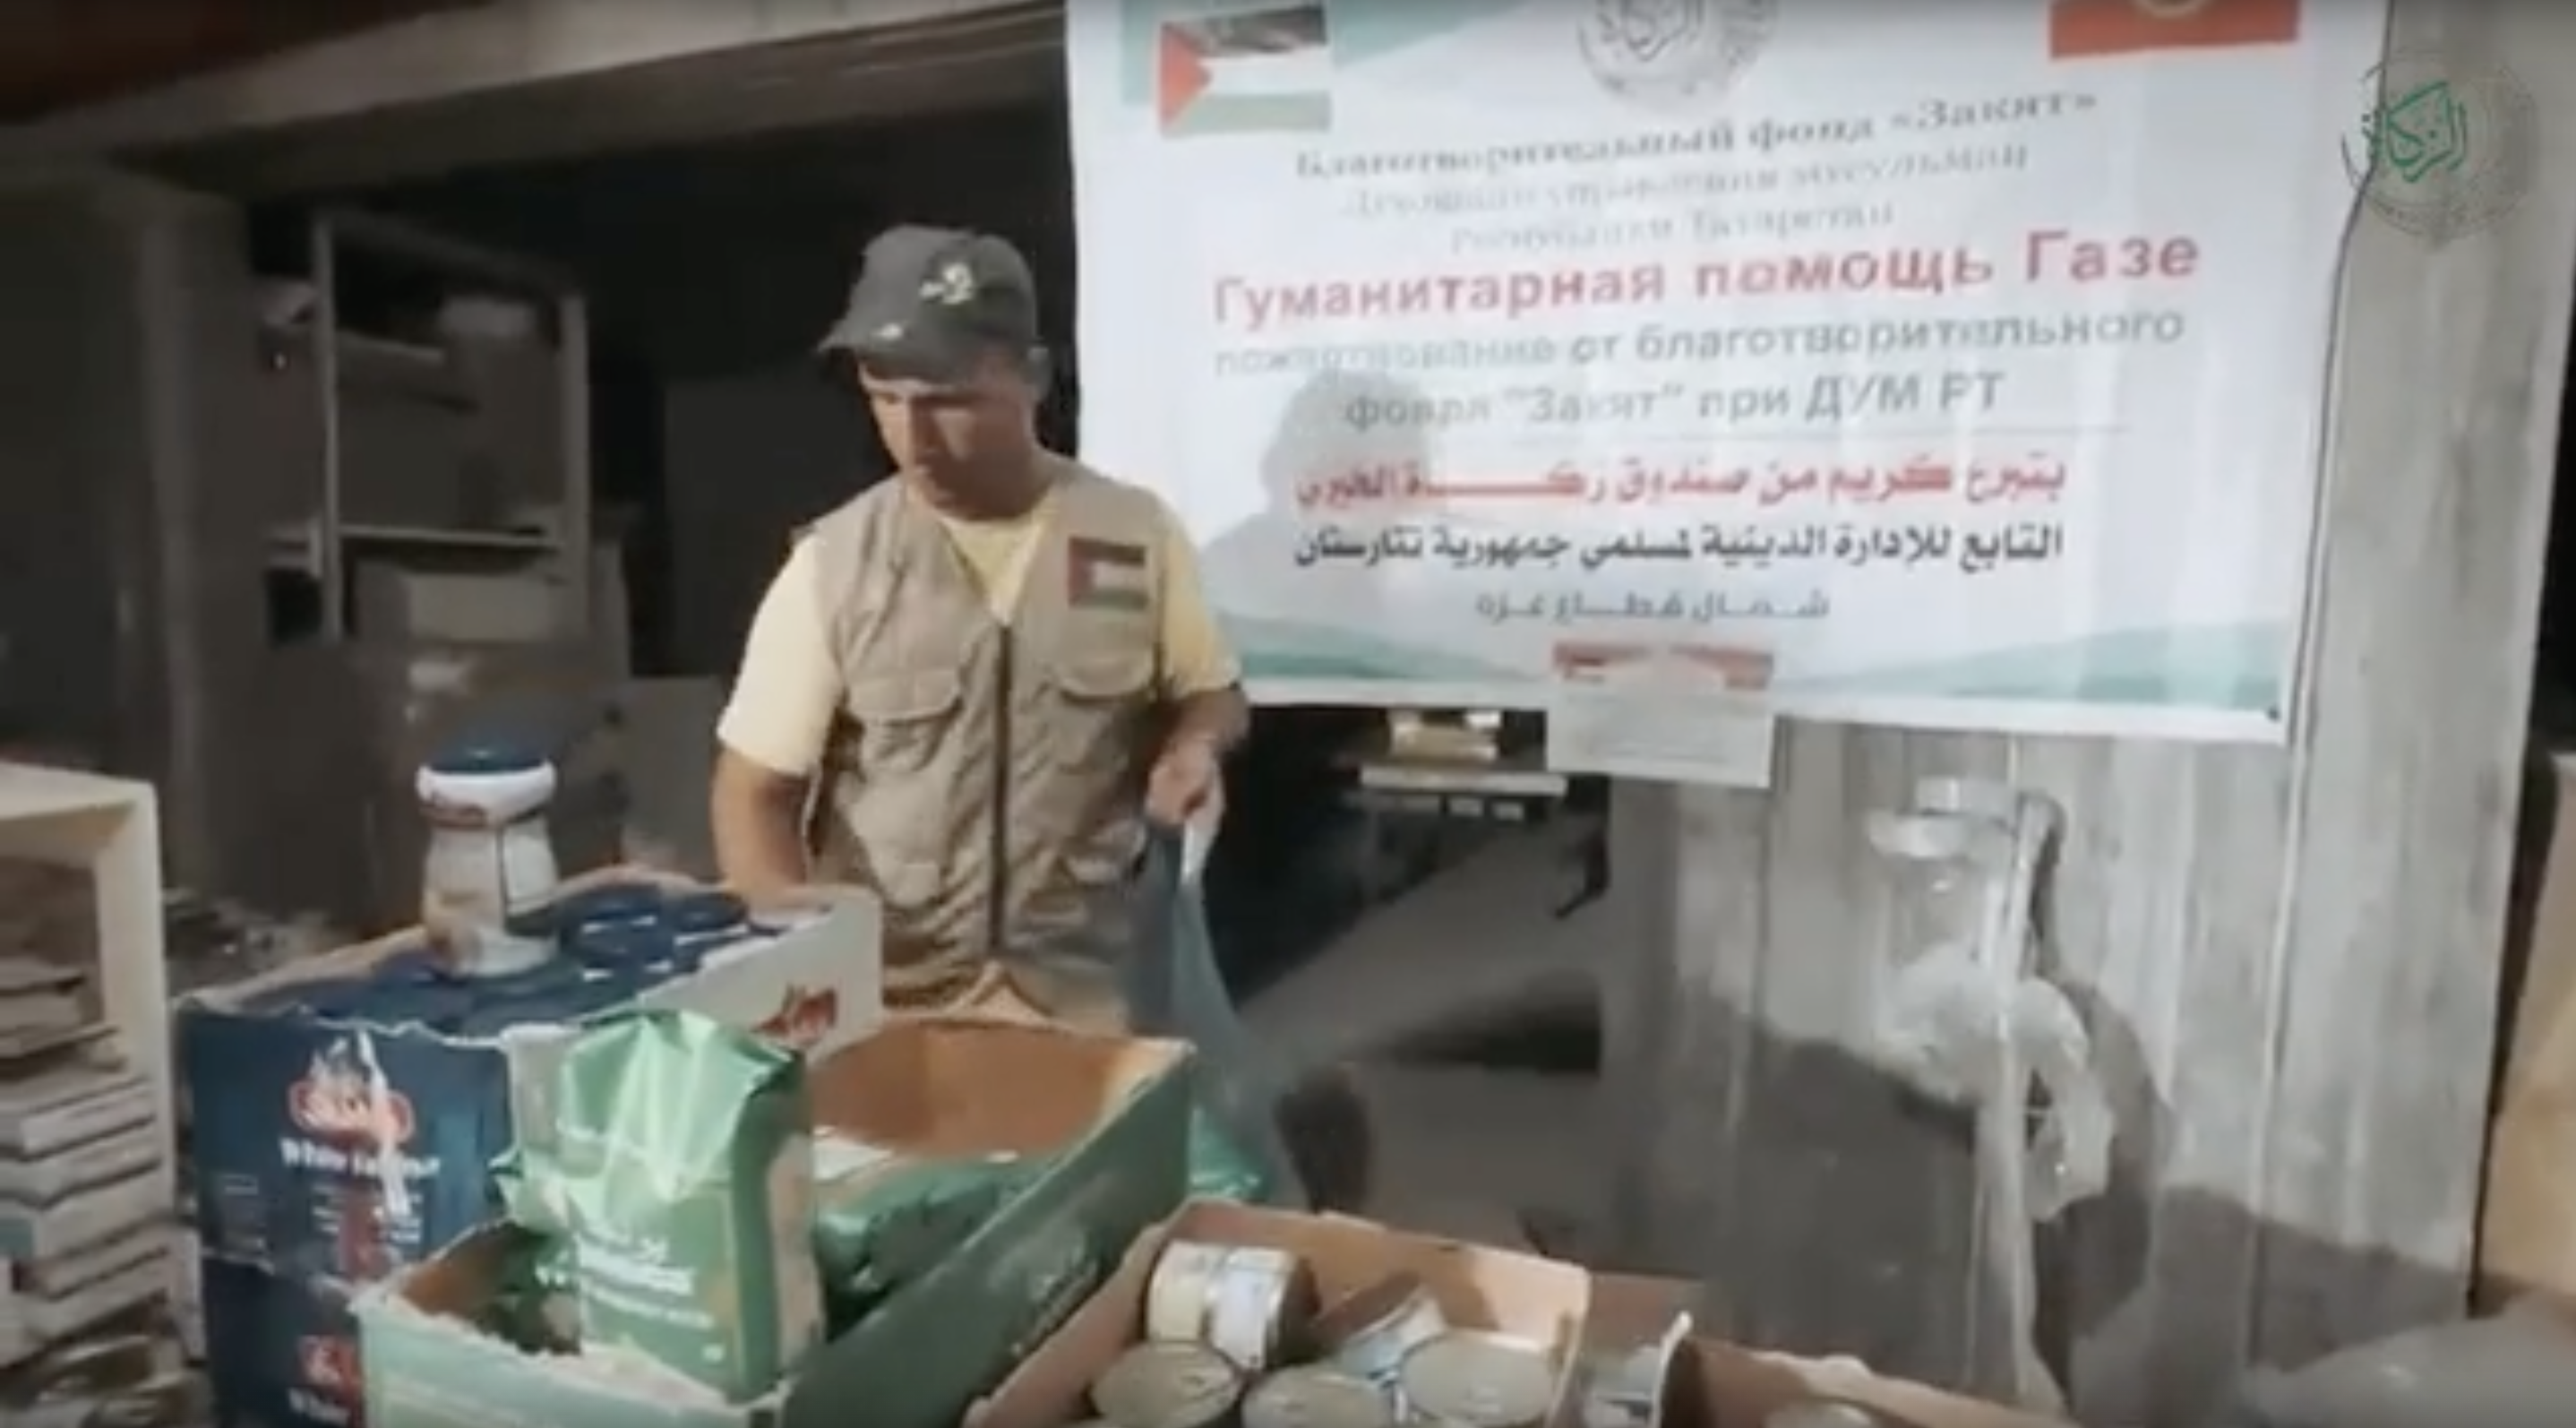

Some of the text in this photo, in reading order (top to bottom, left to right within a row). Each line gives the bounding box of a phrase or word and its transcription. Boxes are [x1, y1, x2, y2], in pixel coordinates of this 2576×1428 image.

[1748, 116, 1874, 151] фонд
[1214, 229, 2200, 331] Гуманитарная помощь Газе
[1569, 331, 1623, 365] от
[1636, 309, 2185, 361] благотворительного
[1699, 390, 1790, 423] при
[1804, 374, 1919, 421] ДУМ
[1939, 371, 2006, 409] РТ
[1757, 460, 1816, 504] من
[1829, 452, 1953, 504] كريم
[1433, 523, 1571, 570] جمهورية
[1700, 522, 1826, 570] الدينية
[1959, 523, 2065, 573] التابع
